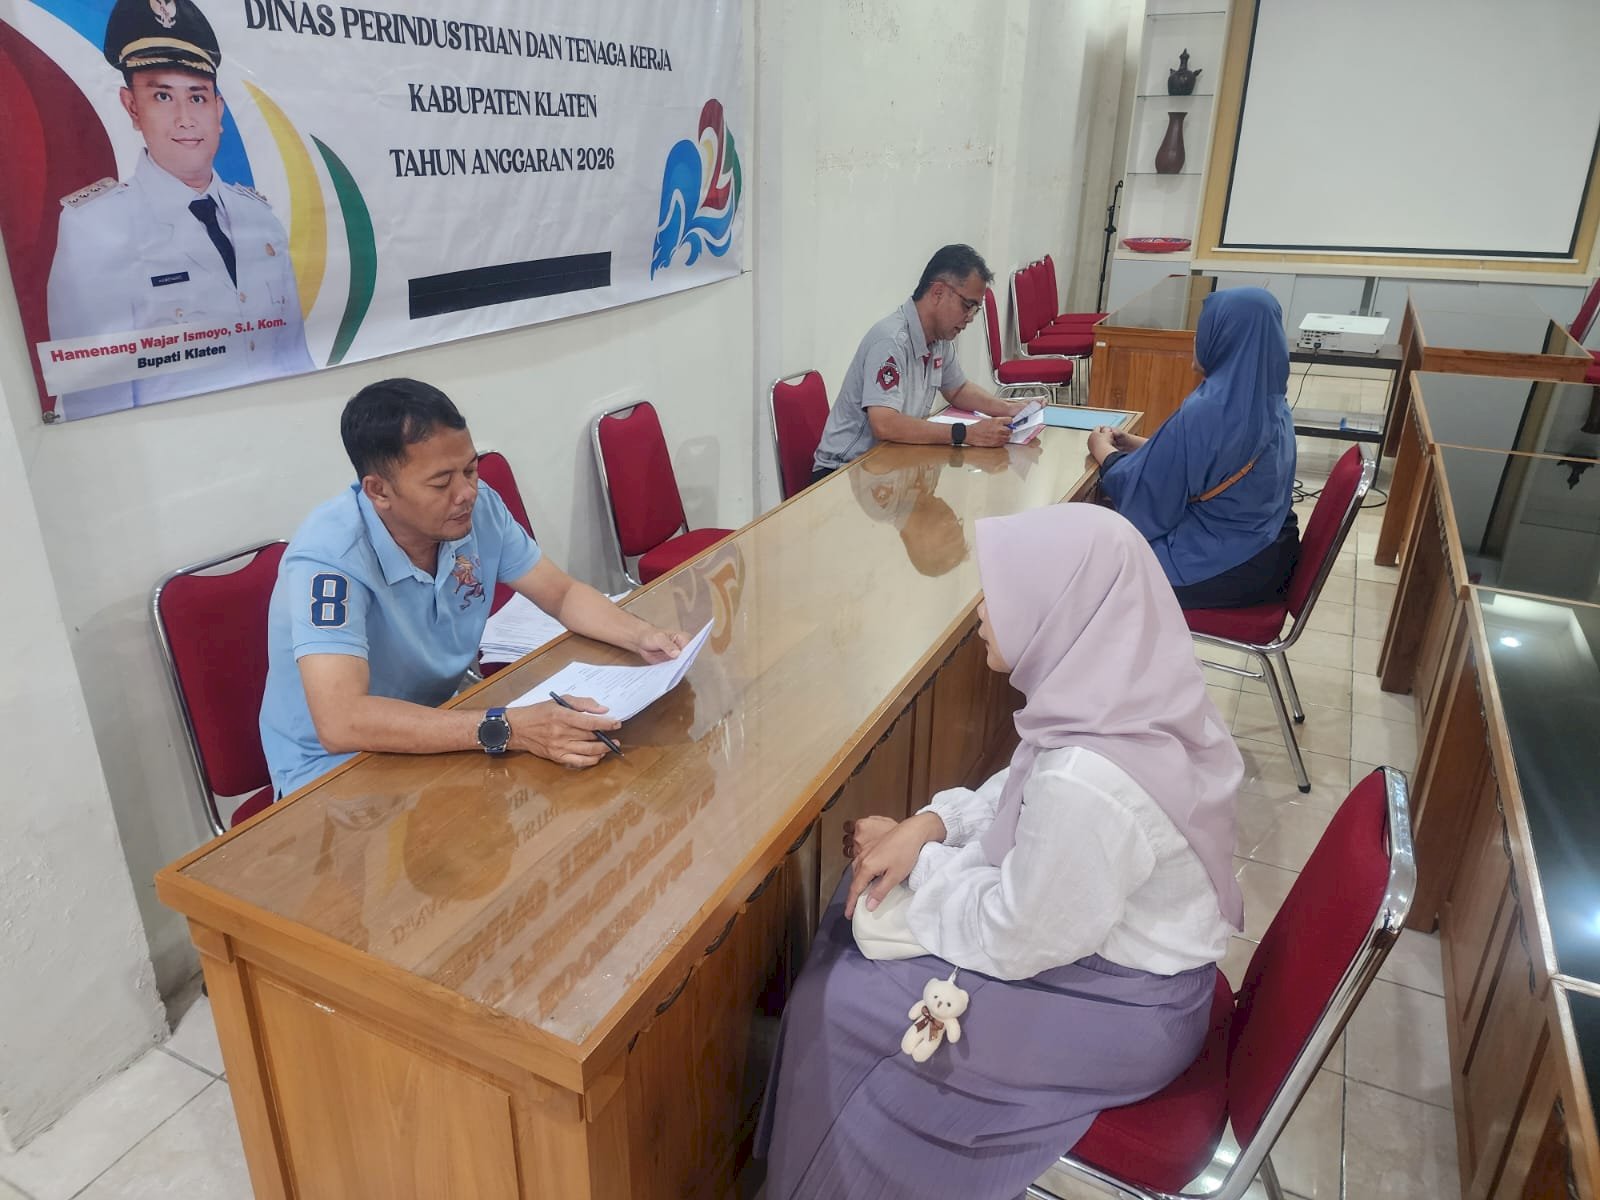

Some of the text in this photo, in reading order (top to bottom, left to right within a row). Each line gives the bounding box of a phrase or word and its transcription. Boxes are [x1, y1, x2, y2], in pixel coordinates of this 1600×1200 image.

[243, 0, 673, 71] DINAS PERINDUSTRIAN DAN TENAGA KERJA
[408, 83, 598, 118] KABUPATEN KLATEN
[389, 147, 615, 177] TAHUN ANGGARAN 2026
[50, 340, 137, 363] Hamenang
[140, 334, 180, 351] Wajar
[183, 326, 232, 343] Ismoyo,
[257, 317, 288, 331] Kom.
[137, 343, 227, 369] Bupati Klaten
[310, 572, 349, 629] 8
